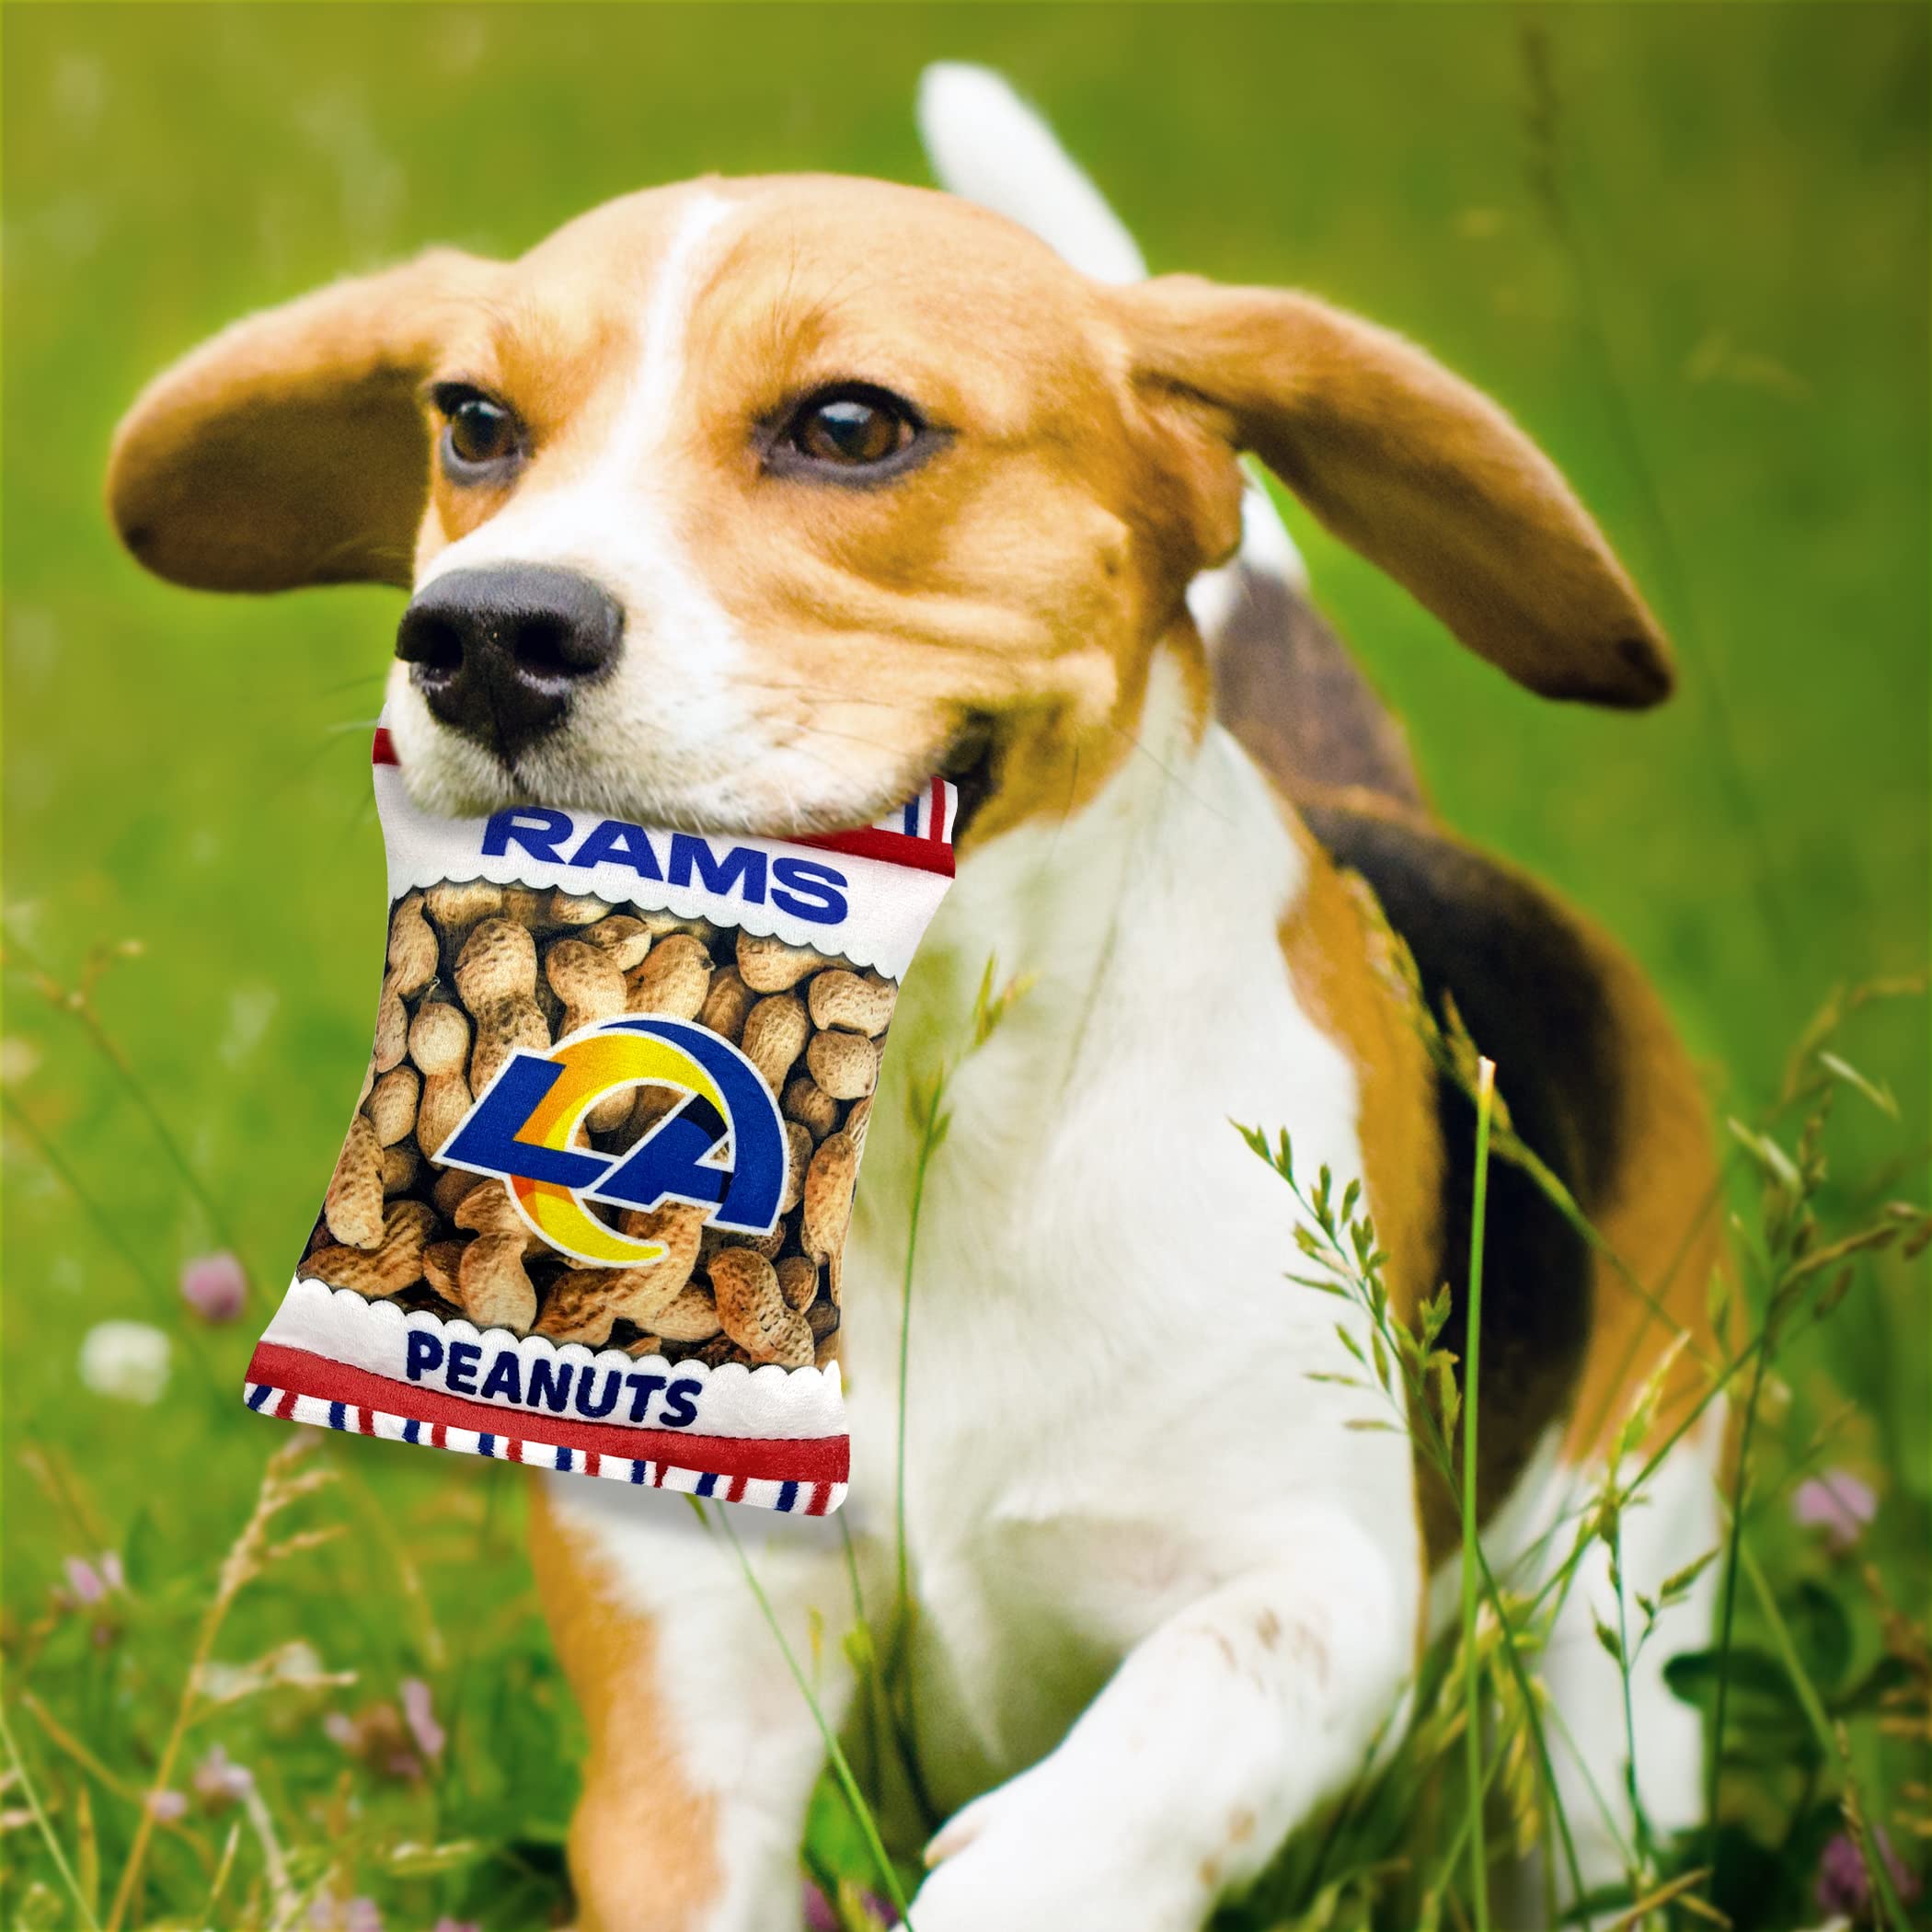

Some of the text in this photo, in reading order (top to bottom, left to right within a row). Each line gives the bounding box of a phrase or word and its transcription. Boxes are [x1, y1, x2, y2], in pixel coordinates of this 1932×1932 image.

[480, 805, 849, 925] RAMS
[435, 1015, 788, 1253] LA
[405, 1330, 704, 1429] PEANUTS
